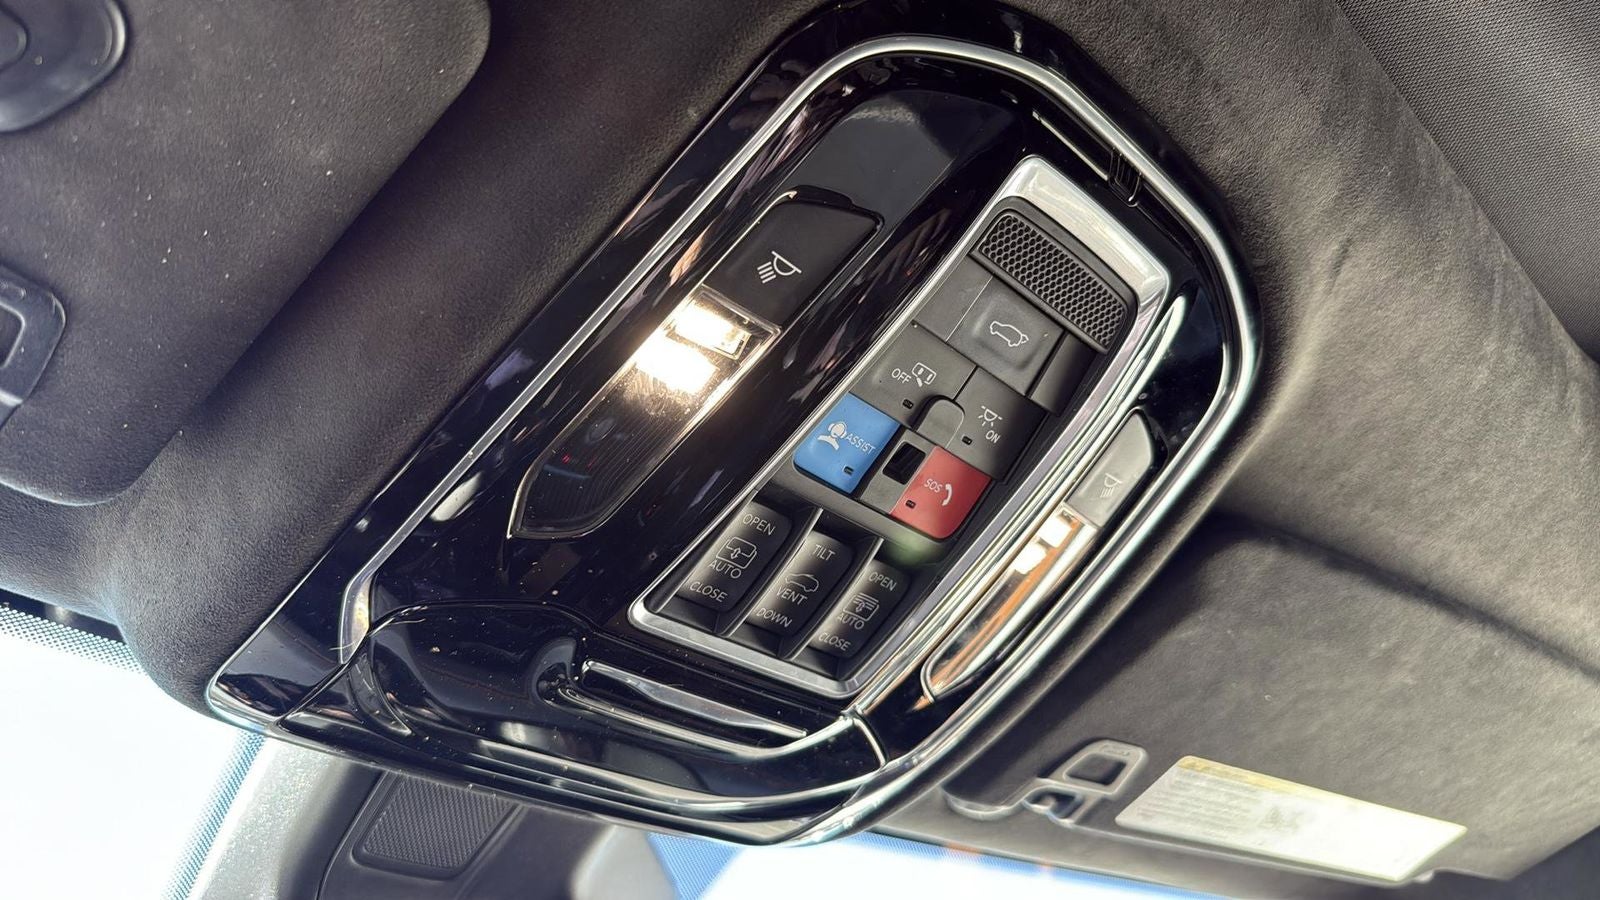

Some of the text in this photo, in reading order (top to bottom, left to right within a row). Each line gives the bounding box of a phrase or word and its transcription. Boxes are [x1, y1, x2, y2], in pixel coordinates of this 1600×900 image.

[891, 367, 912, 384] OFF
[846, 431, 876, 455] ASSIST
[985, 430, 1001, 444] ON
[923, 478, 944, 494] SOS
[743, 513, 776, 536] OPEN
[814, 544, 836, 561] TILT
[708, 559, 742, 579] AUTO
[868, 571, 897, 591] OPEN
[690, 581, 728, 602] CLOSE
[776, 586, 808, 605] VENT
[756, 607, 792, 628] DOWN
[837, 612, 865, 630] AUTO
[818, 632, 851, 651] CLOSE
